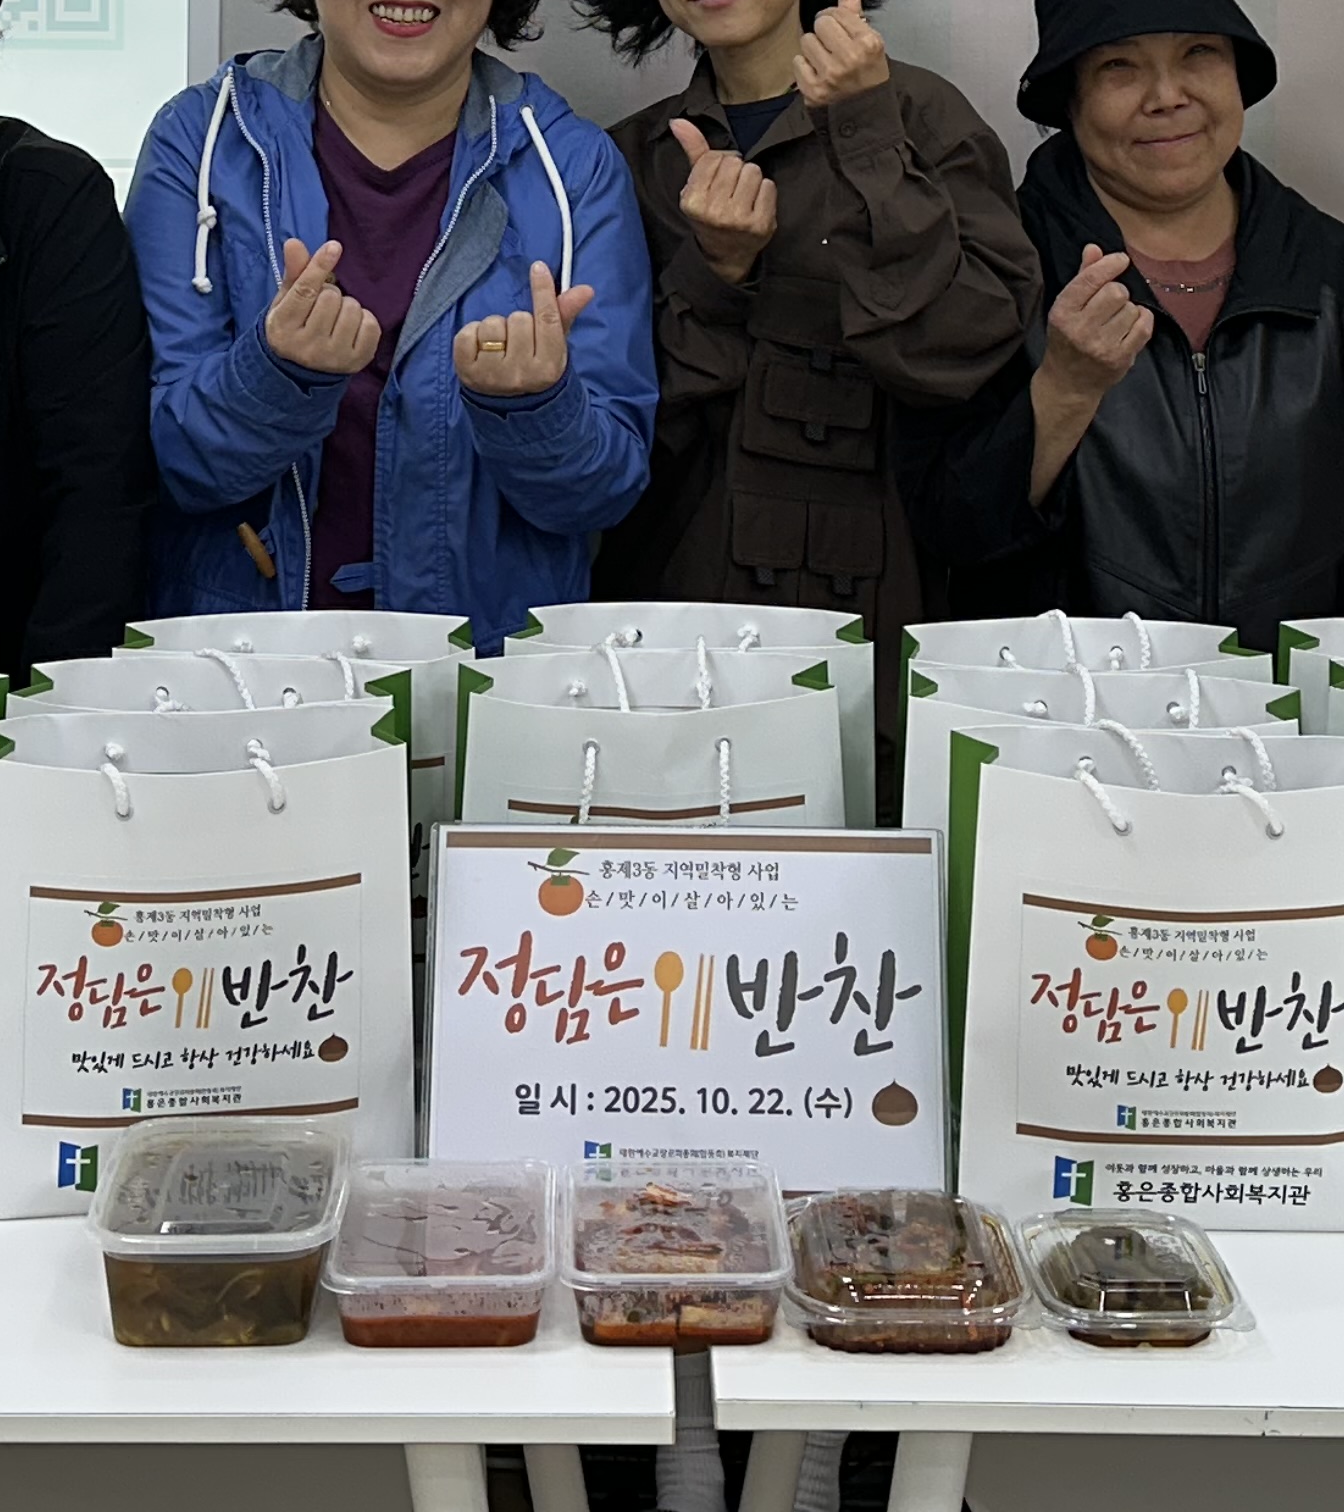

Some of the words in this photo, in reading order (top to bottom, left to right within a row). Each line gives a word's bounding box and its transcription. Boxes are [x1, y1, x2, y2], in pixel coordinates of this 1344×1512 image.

[598, 861, 659, 880] 홍제3동
[662, 860, 743, 882] 지역밀착형
[747, 862, 781, 882] 사업
[238, 903, 261, 918] 사업
[36, 955, 166, 1030] 정담은
[222, 944, 354, 1030] 반찬
[458, 930, 645, 1045] 정담은
[726, 931, 922, 1058] 반찬
[1030, 967, 1161, 1044] 정담은
[72, 1051, 124, 1074] 맛있게
[132, 1050, 174, 1070] 드시고
[180, 1048, 220, 1070] 항상
[225, 1040, 315, 1067] 건강하세요
[1066, 1064, 1120, 1088] 맛있게
[1126, 1069, 1169, 1088] 드시고
[1174, 1068, 1213, 1091] 항상
[1219, 1068, 1310, 1091] 건강하세요
[603, 1086, 686, 1115] 2025.
[696, 1087, 738, 1115] 10.
[748, 1087, 793, 1115] 22.
[803, 1086, 853, 1119] (수)
[1112, 1180, 1311, 1206] 홍은종합사회복지관
